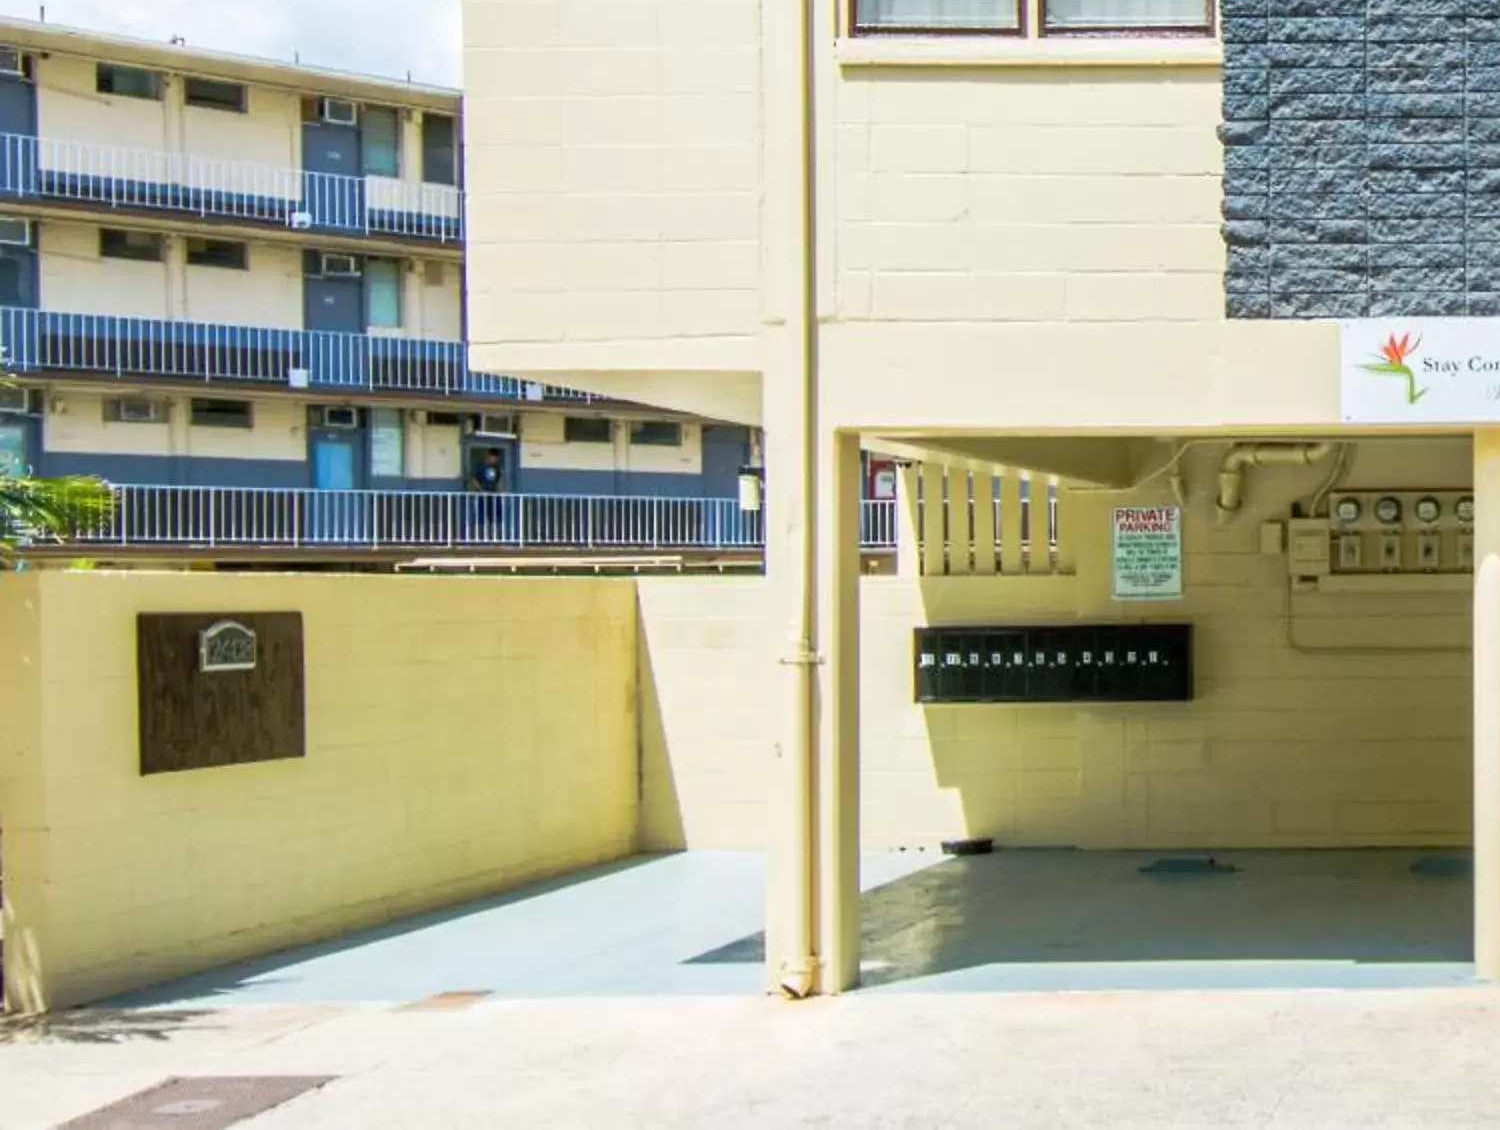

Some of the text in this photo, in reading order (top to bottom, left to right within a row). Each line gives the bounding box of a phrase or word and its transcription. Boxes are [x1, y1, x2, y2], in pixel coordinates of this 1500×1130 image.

[1422, 355, 1461, 377] Stay
[1115, 508, 1176, 522] PRIVATE
[1119, 521, 1172, 533] PARKING
